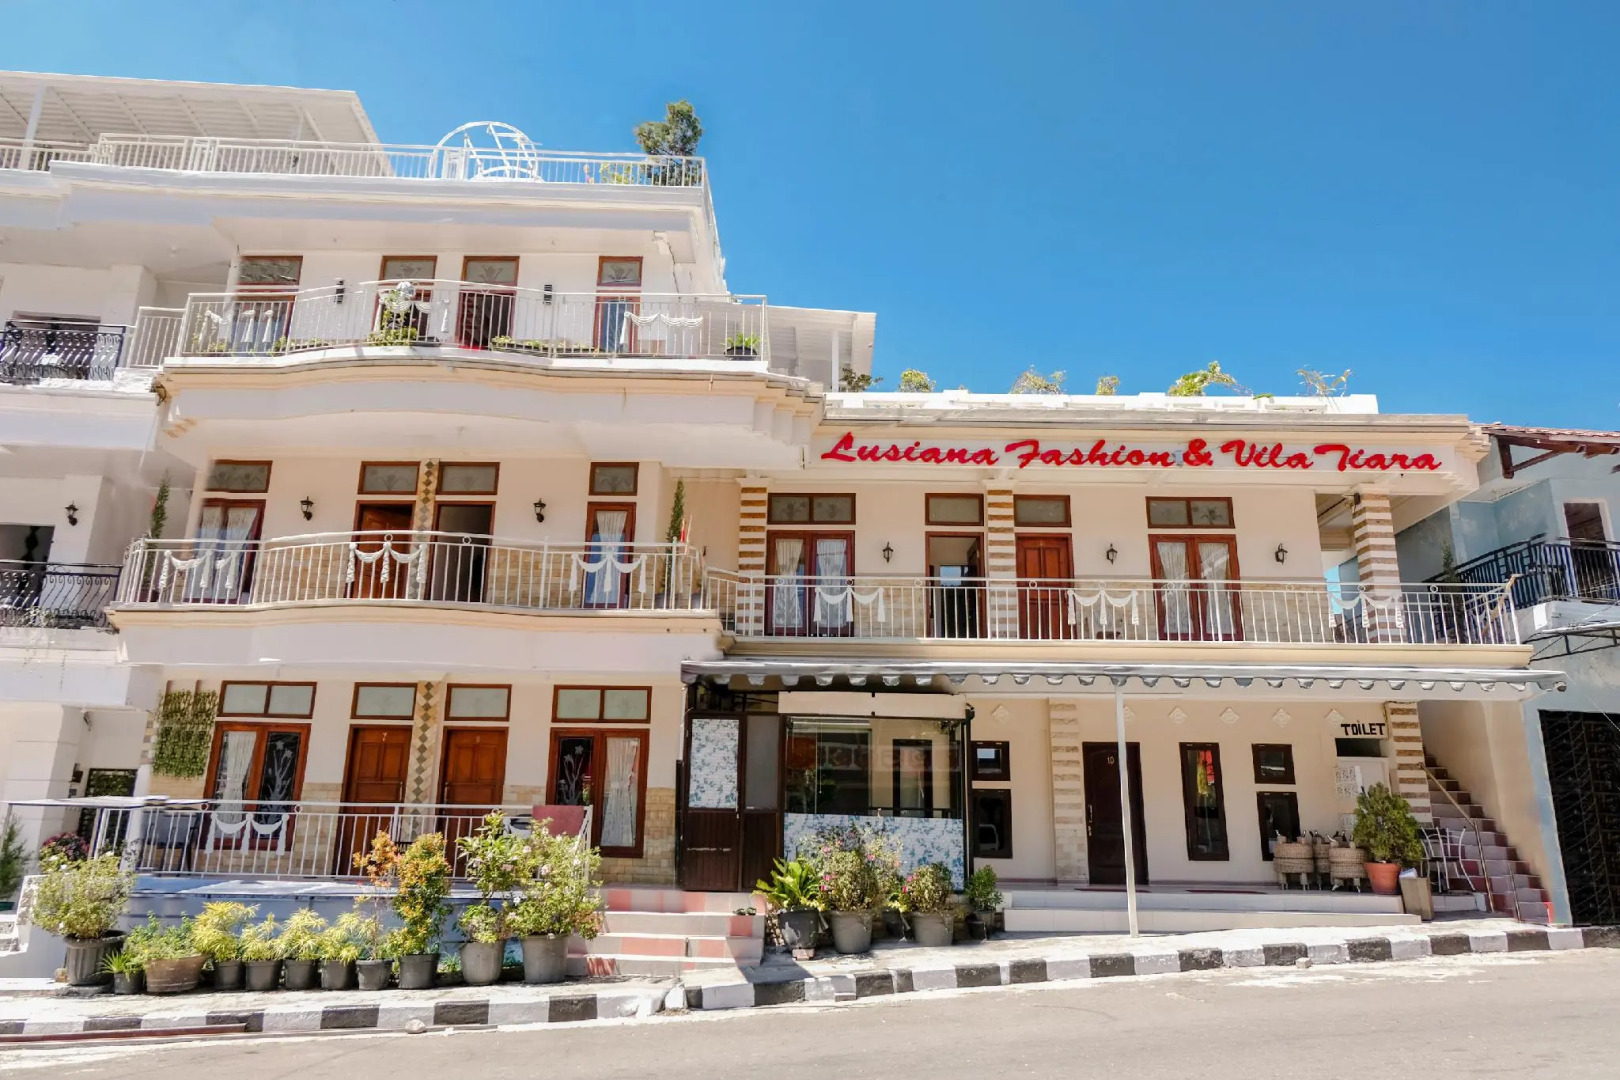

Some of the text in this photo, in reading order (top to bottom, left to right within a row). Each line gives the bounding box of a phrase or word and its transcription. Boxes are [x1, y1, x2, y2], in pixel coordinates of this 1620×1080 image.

[820, 431, 1442, 472] Lusiana Fashion & Vila Tiara
[1107, 756, 1115, 765] 10
